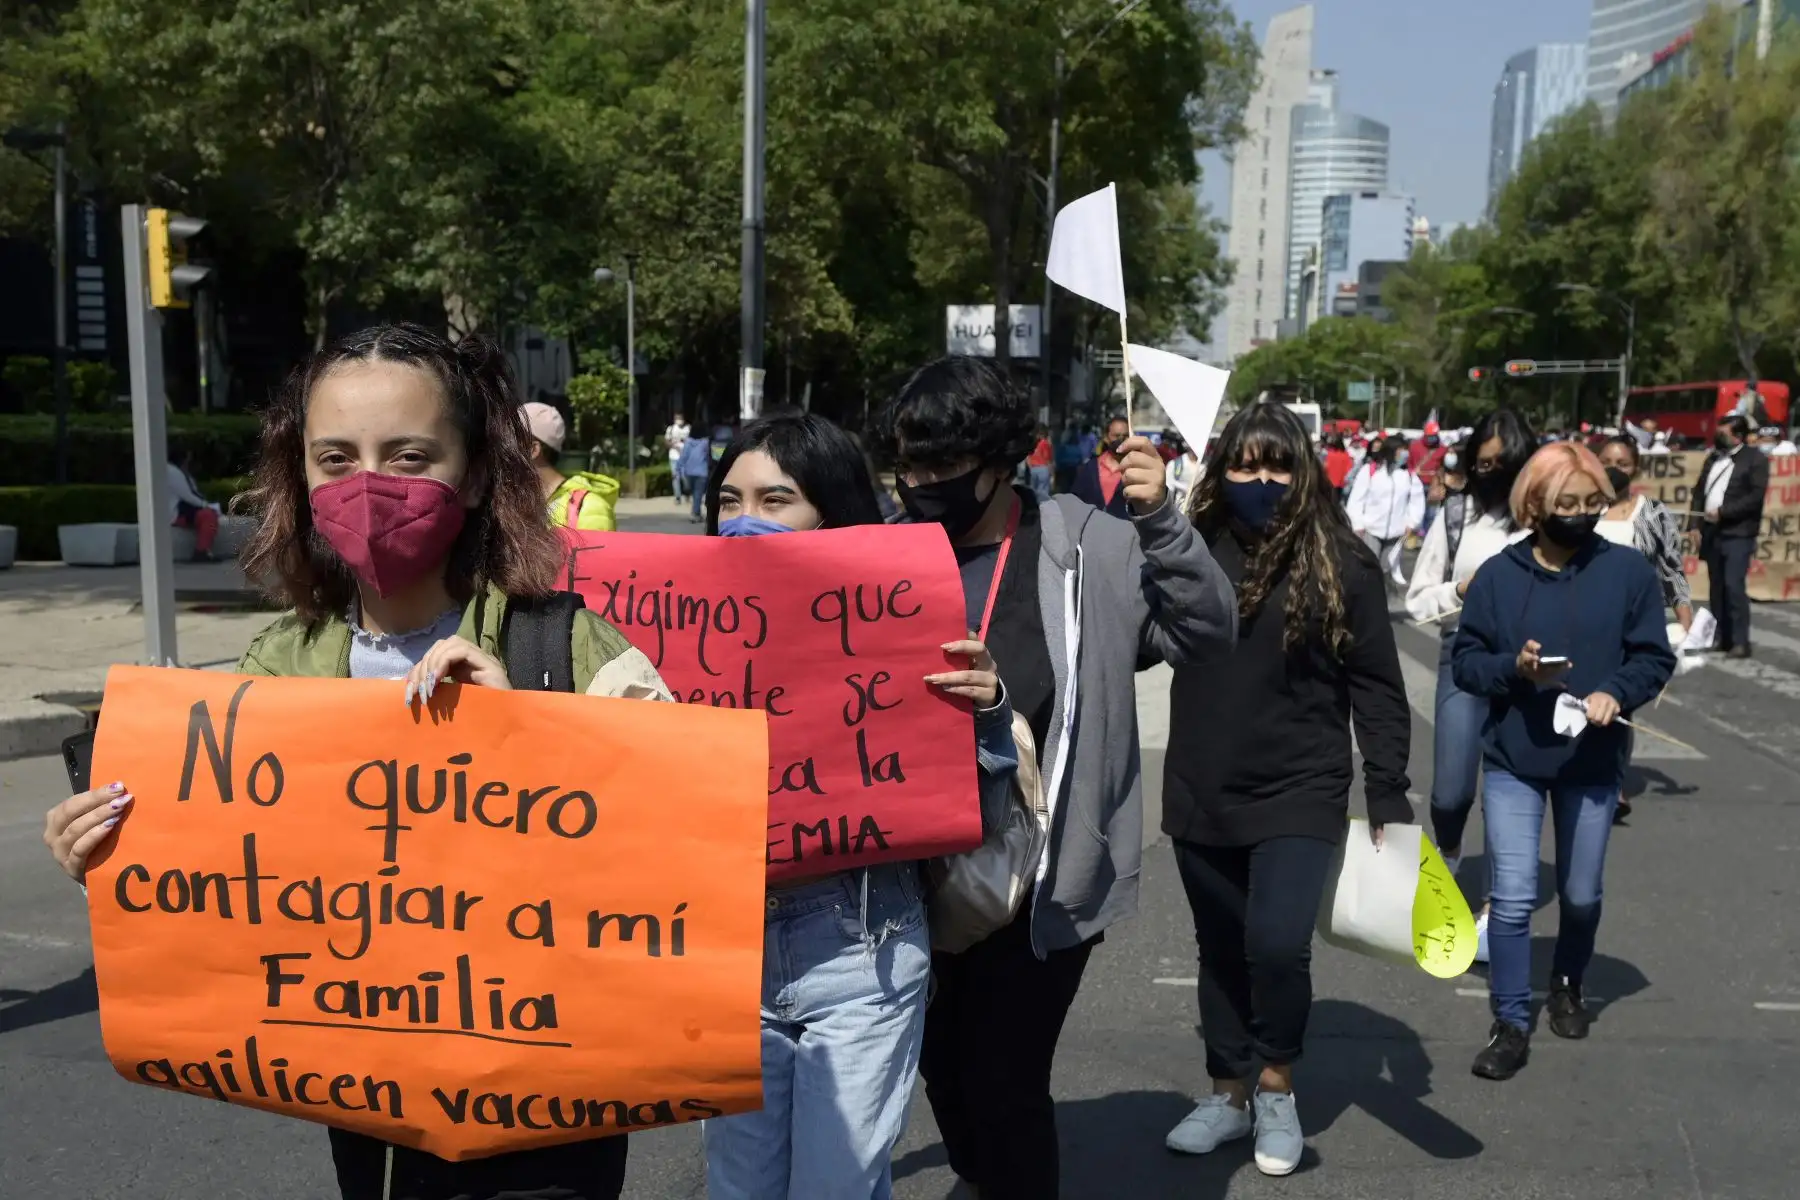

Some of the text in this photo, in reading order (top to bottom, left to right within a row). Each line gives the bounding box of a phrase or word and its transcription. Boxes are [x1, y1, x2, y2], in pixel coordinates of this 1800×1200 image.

[954, 323, 1032, 338] HUAEI
[568, 545, 922, 676] Exigimos que
[843, 670, 903, 727] se
[177, 680, 597, 862] No quiero
[855, 728, 906, 788] la
[114, 833, 688, 960] contagiar a mí
[1419, 856, 1456, 960] Vacuna
[260, 952, 559, 1032] Familia
[136, 1036, 723, 1129] agilicen vacunas
